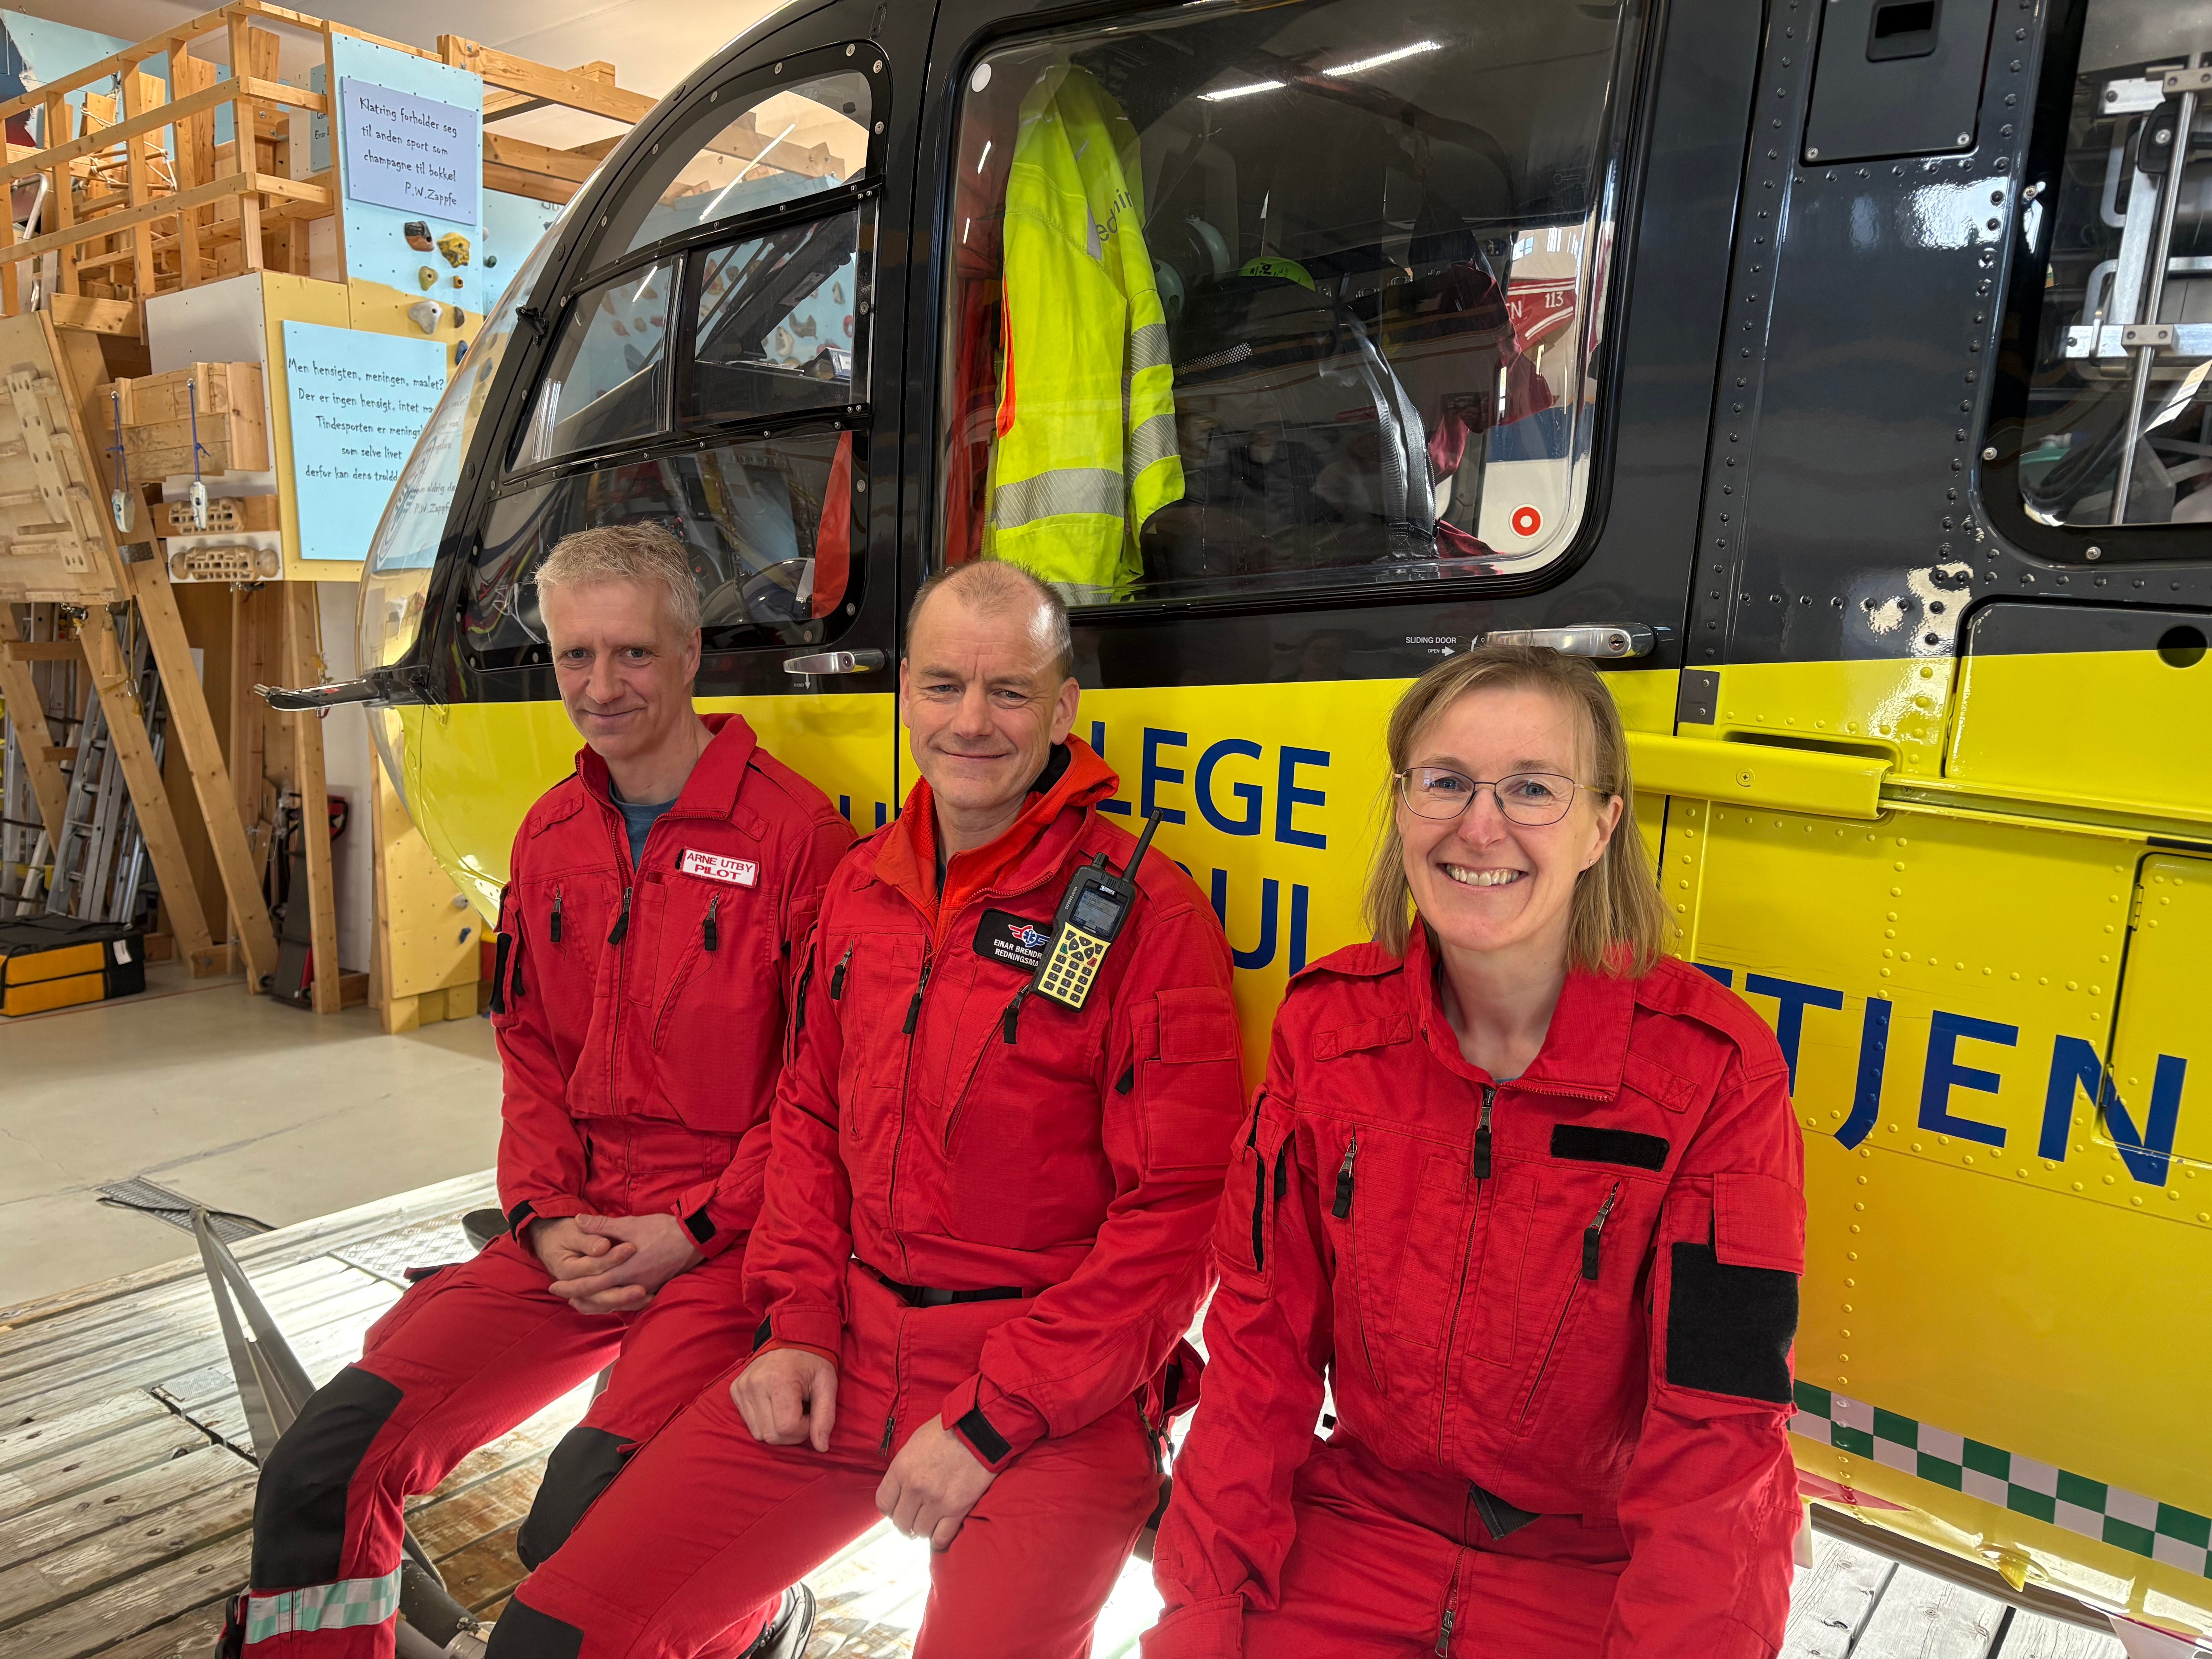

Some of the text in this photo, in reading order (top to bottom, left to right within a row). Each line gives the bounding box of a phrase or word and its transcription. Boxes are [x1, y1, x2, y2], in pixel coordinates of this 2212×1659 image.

[360, 97, 457, 138] Klatring forholder seg
[361, 124, 448, 155] til anden sport som
[364, 149, 456, 182] champagne til bokkøl
[1505, 300, 1522, 319] N
[1545, 291, 1564, 308] 113
[288, 357, 444, 390] Men hensigten, meningen, maalet?
[298, 387, 315, 402] Der
[319, 395, 329, 403] er
[333, 393, 357, 409] ingen
[360, 393, 395, 412] hensigt,
[398, 400, 419, 413] intet
[316, 415, 374, 434] Tindesporten
[390, 424, 423, 440] menings
[342, 445, 403, 460] som selve livet
[306, 464, 398, 482] derfor kan dens troldd
[1091, 720, 1331, 850] LEGE
[687, 852, 753, 873] ARNE UTBY
[694, 864, 741, 880] PILOT
[994, 939, 1042, 960] EINAR BRENDR
[994, 948, 1039, 967] REDNINGSMA
[1685, 961, 2188, 1187] TJEN
